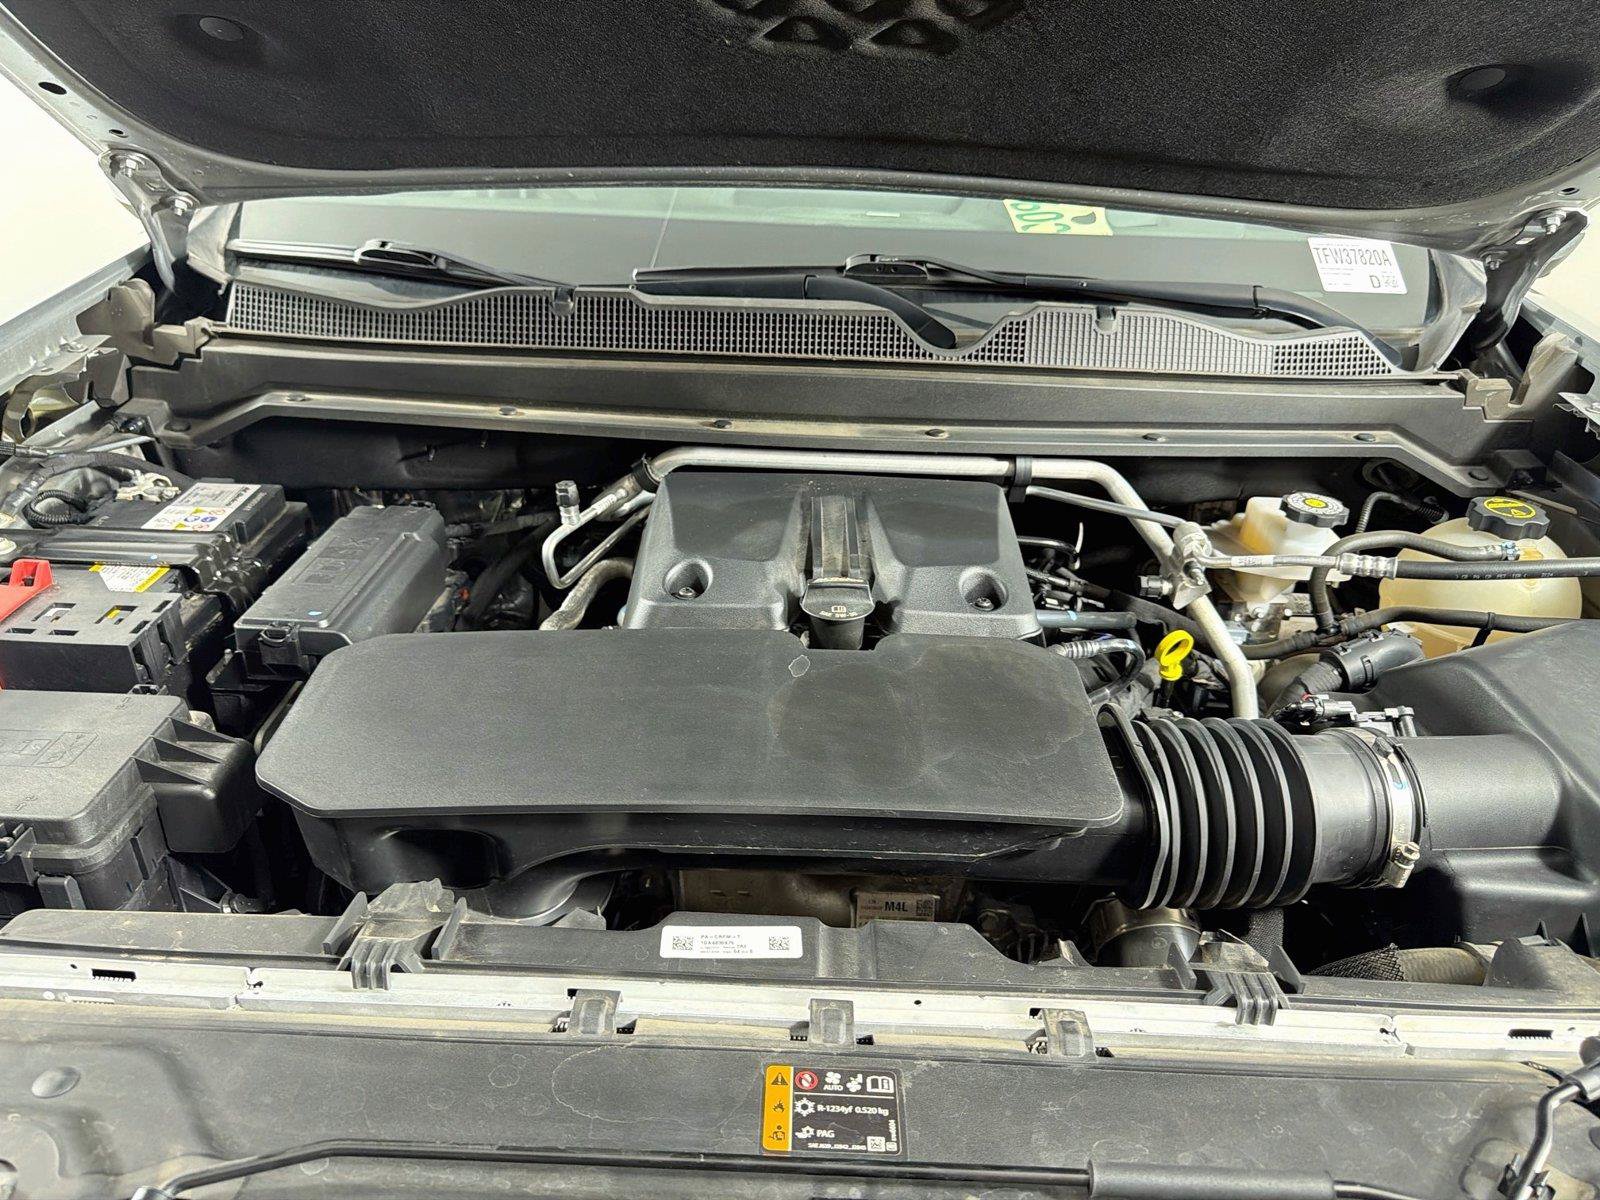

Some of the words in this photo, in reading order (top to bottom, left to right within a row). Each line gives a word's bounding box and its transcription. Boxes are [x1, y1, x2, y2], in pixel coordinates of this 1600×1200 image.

[1313, 247, 1392, 267] TFW37820A
[1369, 275, 1381, 288] D
[884, 901, 908, 912] M4L
[817, 1104, 854, 1115] R-1234yf
[855, 1106, 877, 1114] 0.520
[878, 1107, 889, 1116] kg
[816, 1129, 835, 1138] PAG
